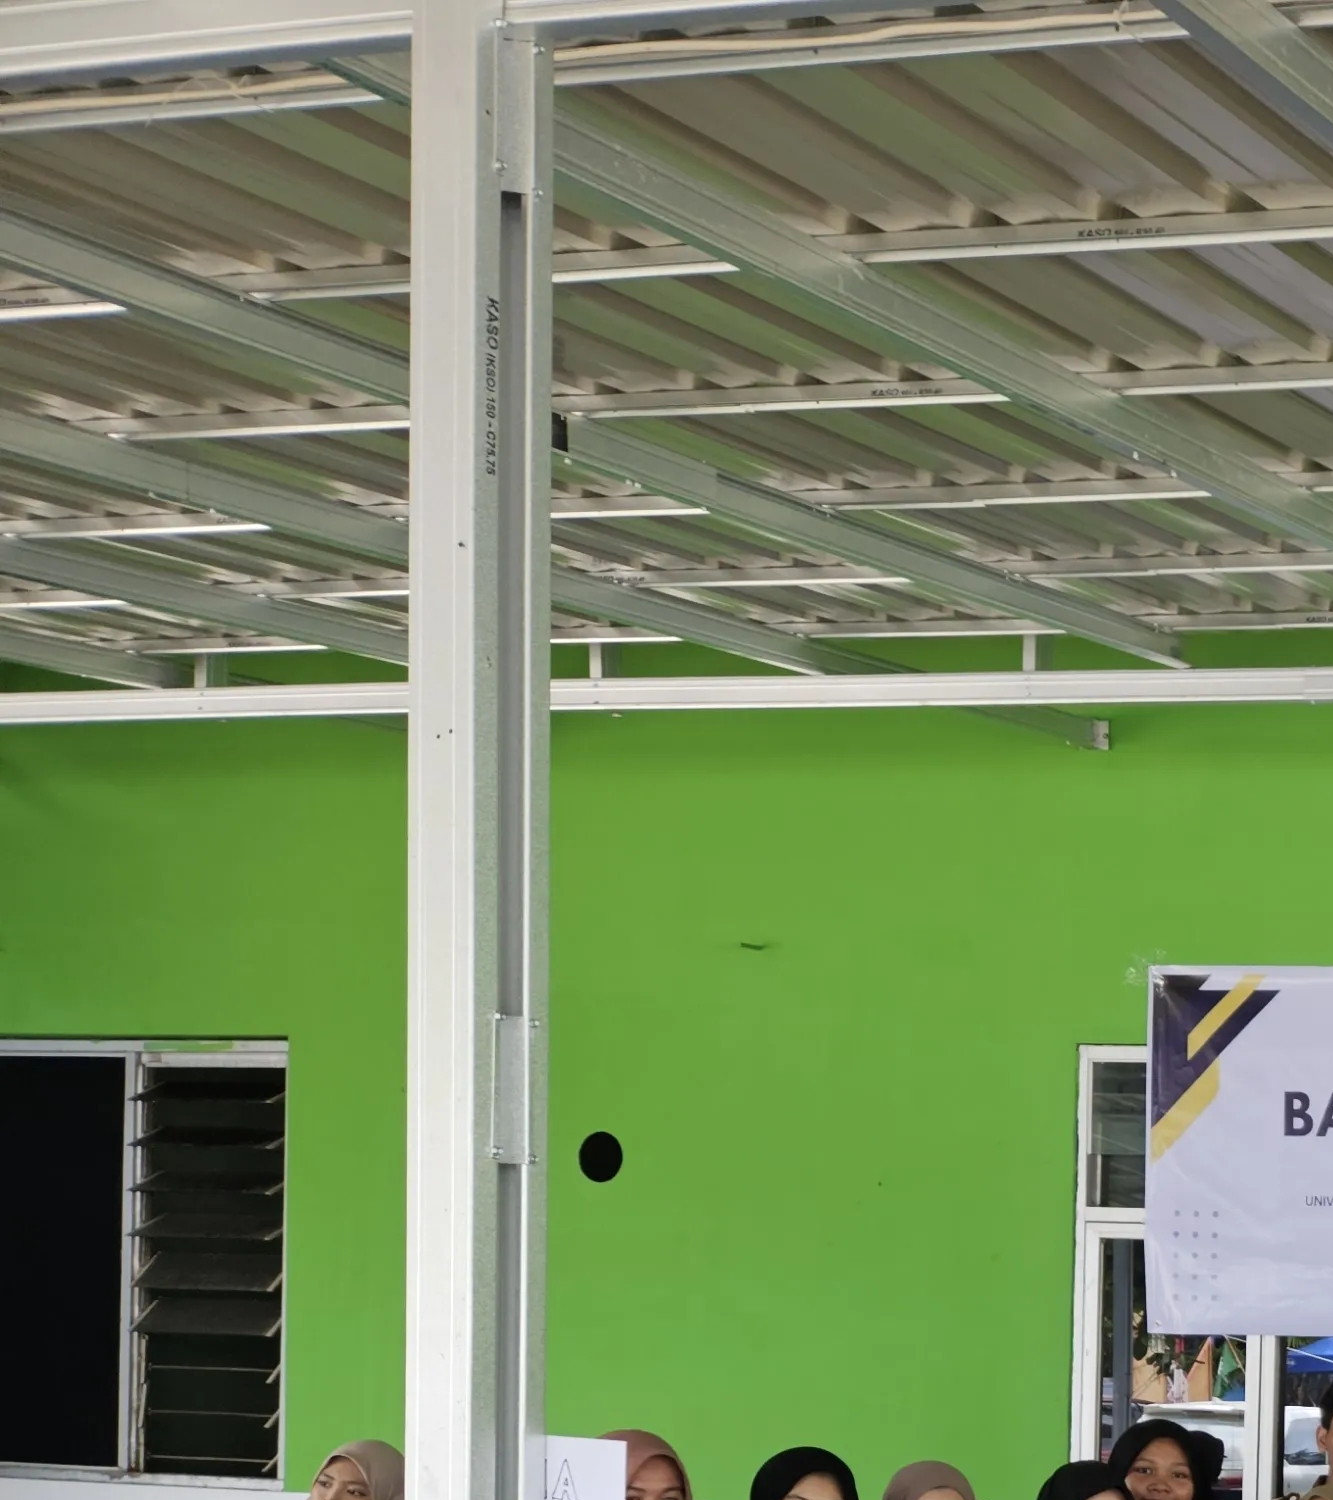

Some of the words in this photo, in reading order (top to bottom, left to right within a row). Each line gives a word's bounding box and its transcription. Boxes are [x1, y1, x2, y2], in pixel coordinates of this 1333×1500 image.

[486, 295, 499, 350] KASO
[485, 352, 497, 393] (KSO)
[485, 396, 496, 418] 150
[485, 430, 496, 476] C75.75
